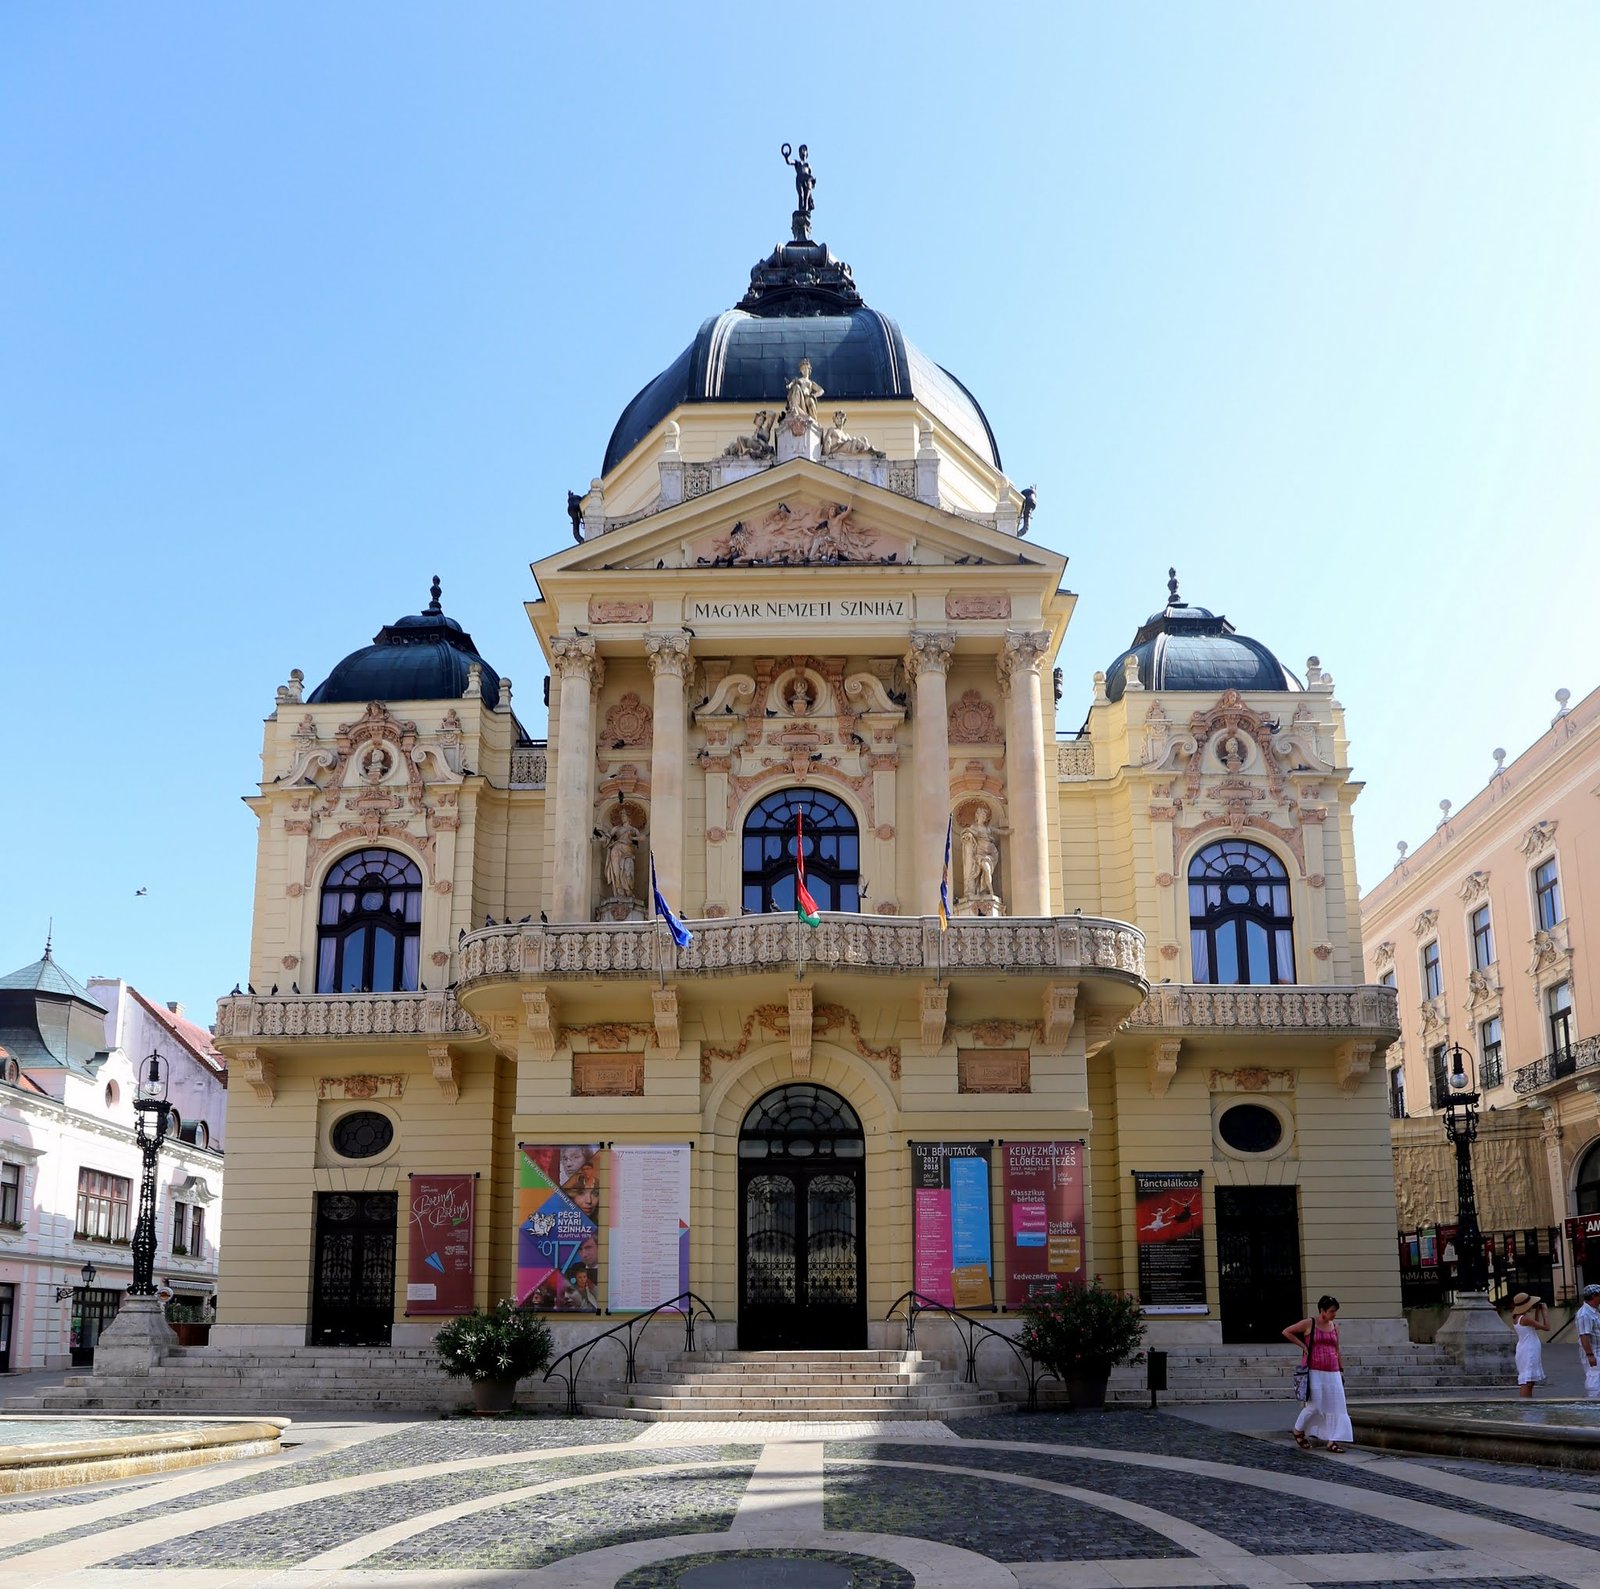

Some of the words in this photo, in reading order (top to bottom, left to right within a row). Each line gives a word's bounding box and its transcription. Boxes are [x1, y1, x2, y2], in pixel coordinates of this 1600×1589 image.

[695, 603, 763, 619] MAGYAR
[766, 601, 831, 617] NEMZETI
[916, 1145, 928, 1157] ÚJ
[932, 1145, 978, 1157] BEMUTATÓK
[1009, 1144, 1076, 1156] KEDVEZMÉNYES
[1010, 1155, 1076, 1166] ELŐBÉRLETEZÉS
[1138, 1178, 1199, 1188] Tánctalálkozó
[557, 1211, 582, 1219] PÉCSI
[557, 1218, 582, 1226] NYÁRI
[557, 1225, 592, 1233] SZÍNHÁZ
[537, 1240, 582, 1275] 2017
[1013, 1272, 1058, 1281] Kedvezmények
